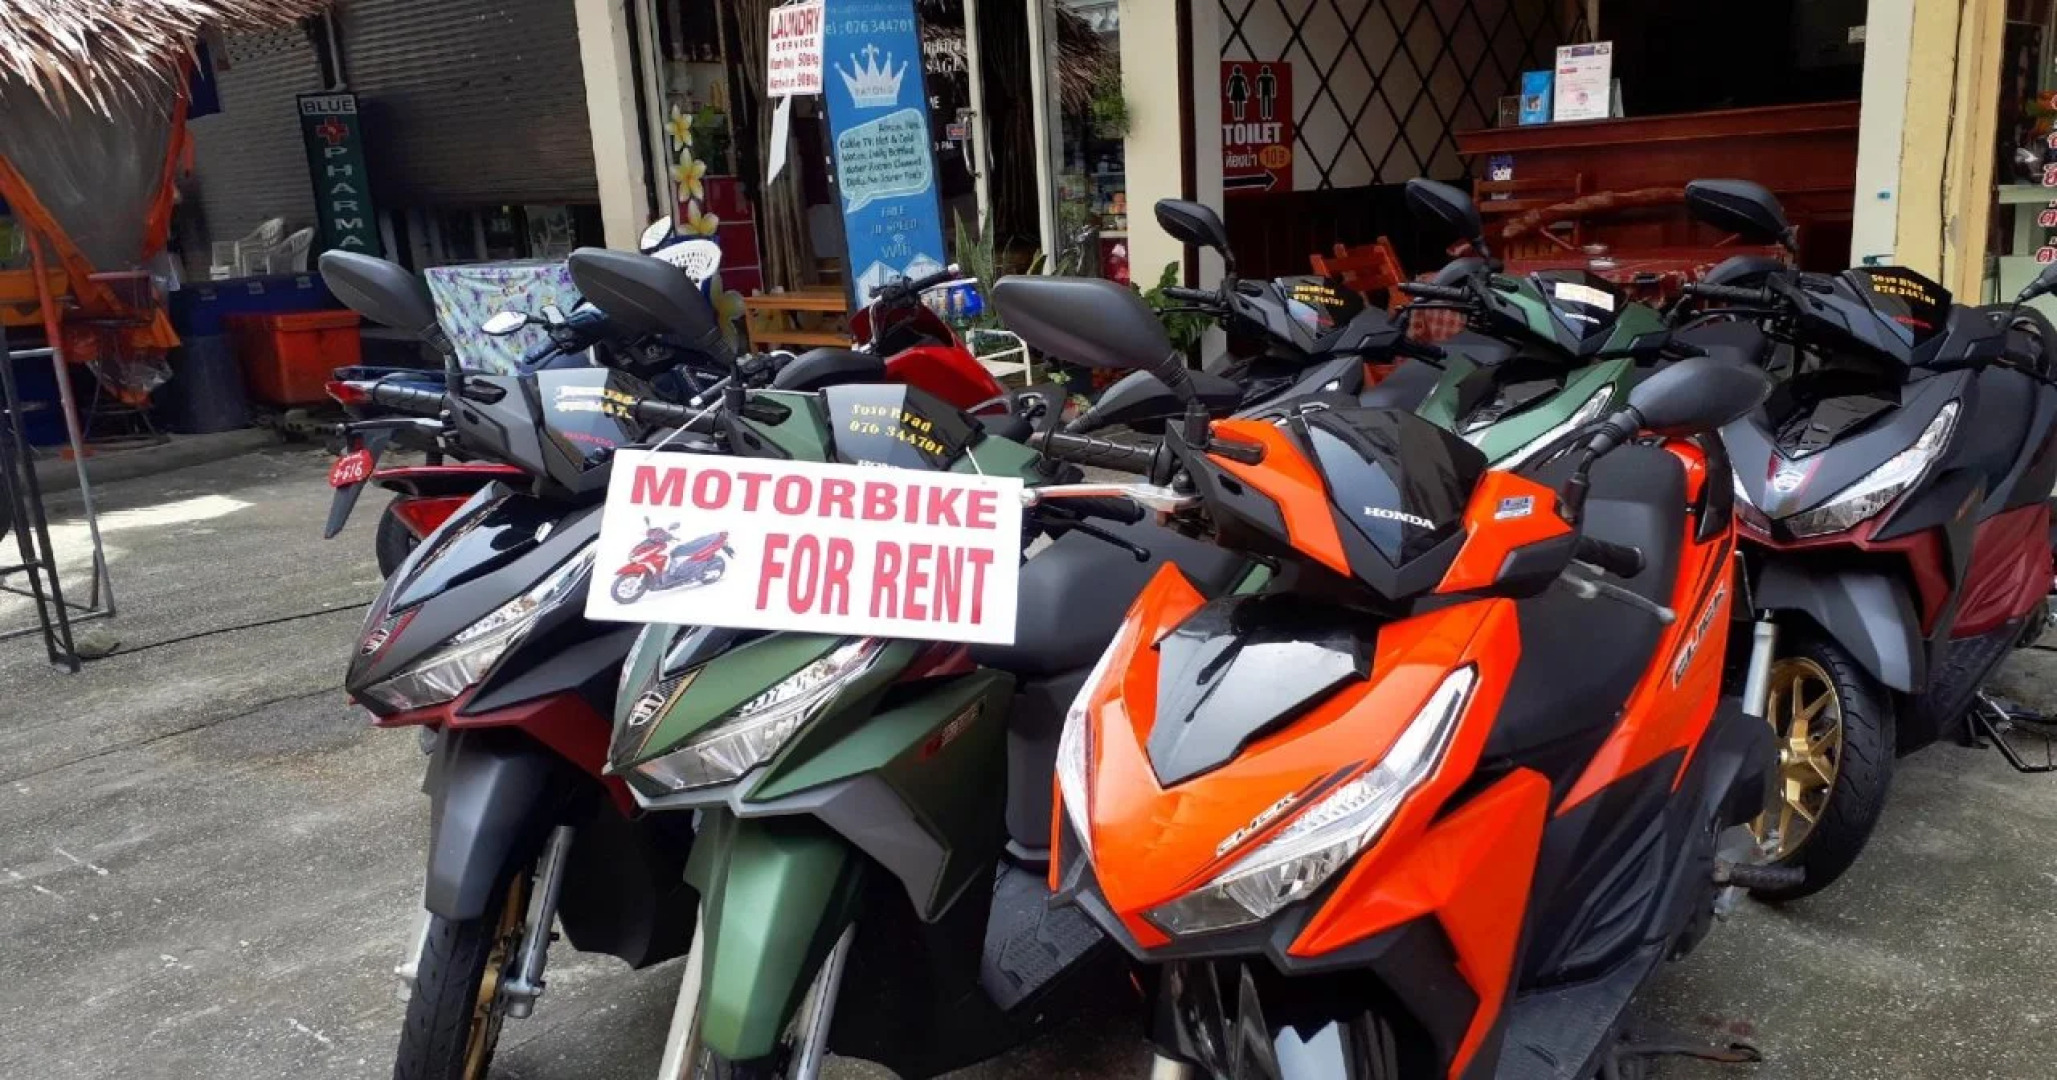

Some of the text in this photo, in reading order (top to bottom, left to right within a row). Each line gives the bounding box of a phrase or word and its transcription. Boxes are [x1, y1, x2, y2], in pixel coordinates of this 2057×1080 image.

[771, 7, 820, 39] LAUNDRY
[775, 38, 814, 52] SERVICE
[303, 101, 354, 114] BLUE
[1222, 121, 1284, 146] TOILET
[629, 465, 999, 530] MOTORBIKE
[1363, 506, 1436, 530] HONDA
[755, 532, 994, 625] FOR RENT
